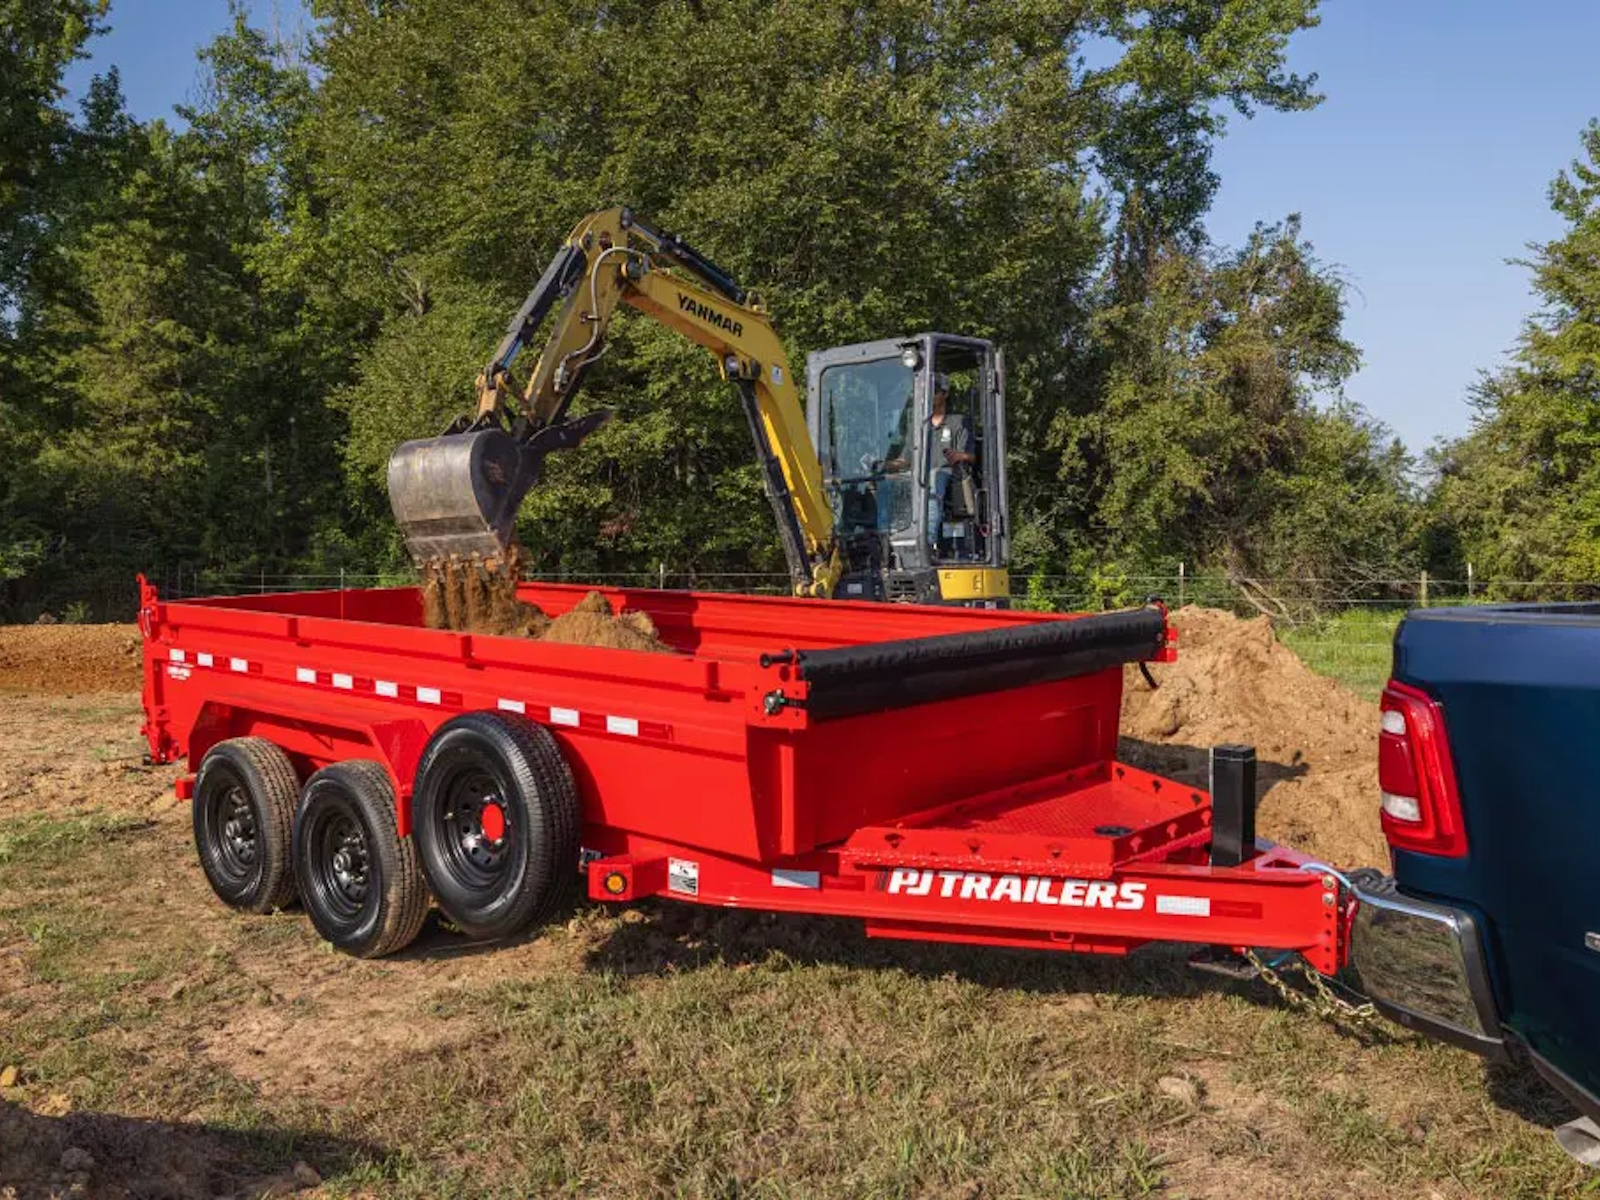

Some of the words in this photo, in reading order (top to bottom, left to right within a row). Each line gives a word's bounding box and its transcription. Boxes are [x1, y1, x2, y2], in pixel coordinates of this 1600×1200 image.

[678, 293, 743, 337] YANMAR
[888, 868, 934, 896] PJ
[938, 871, 1147, 910] TRAILERS
